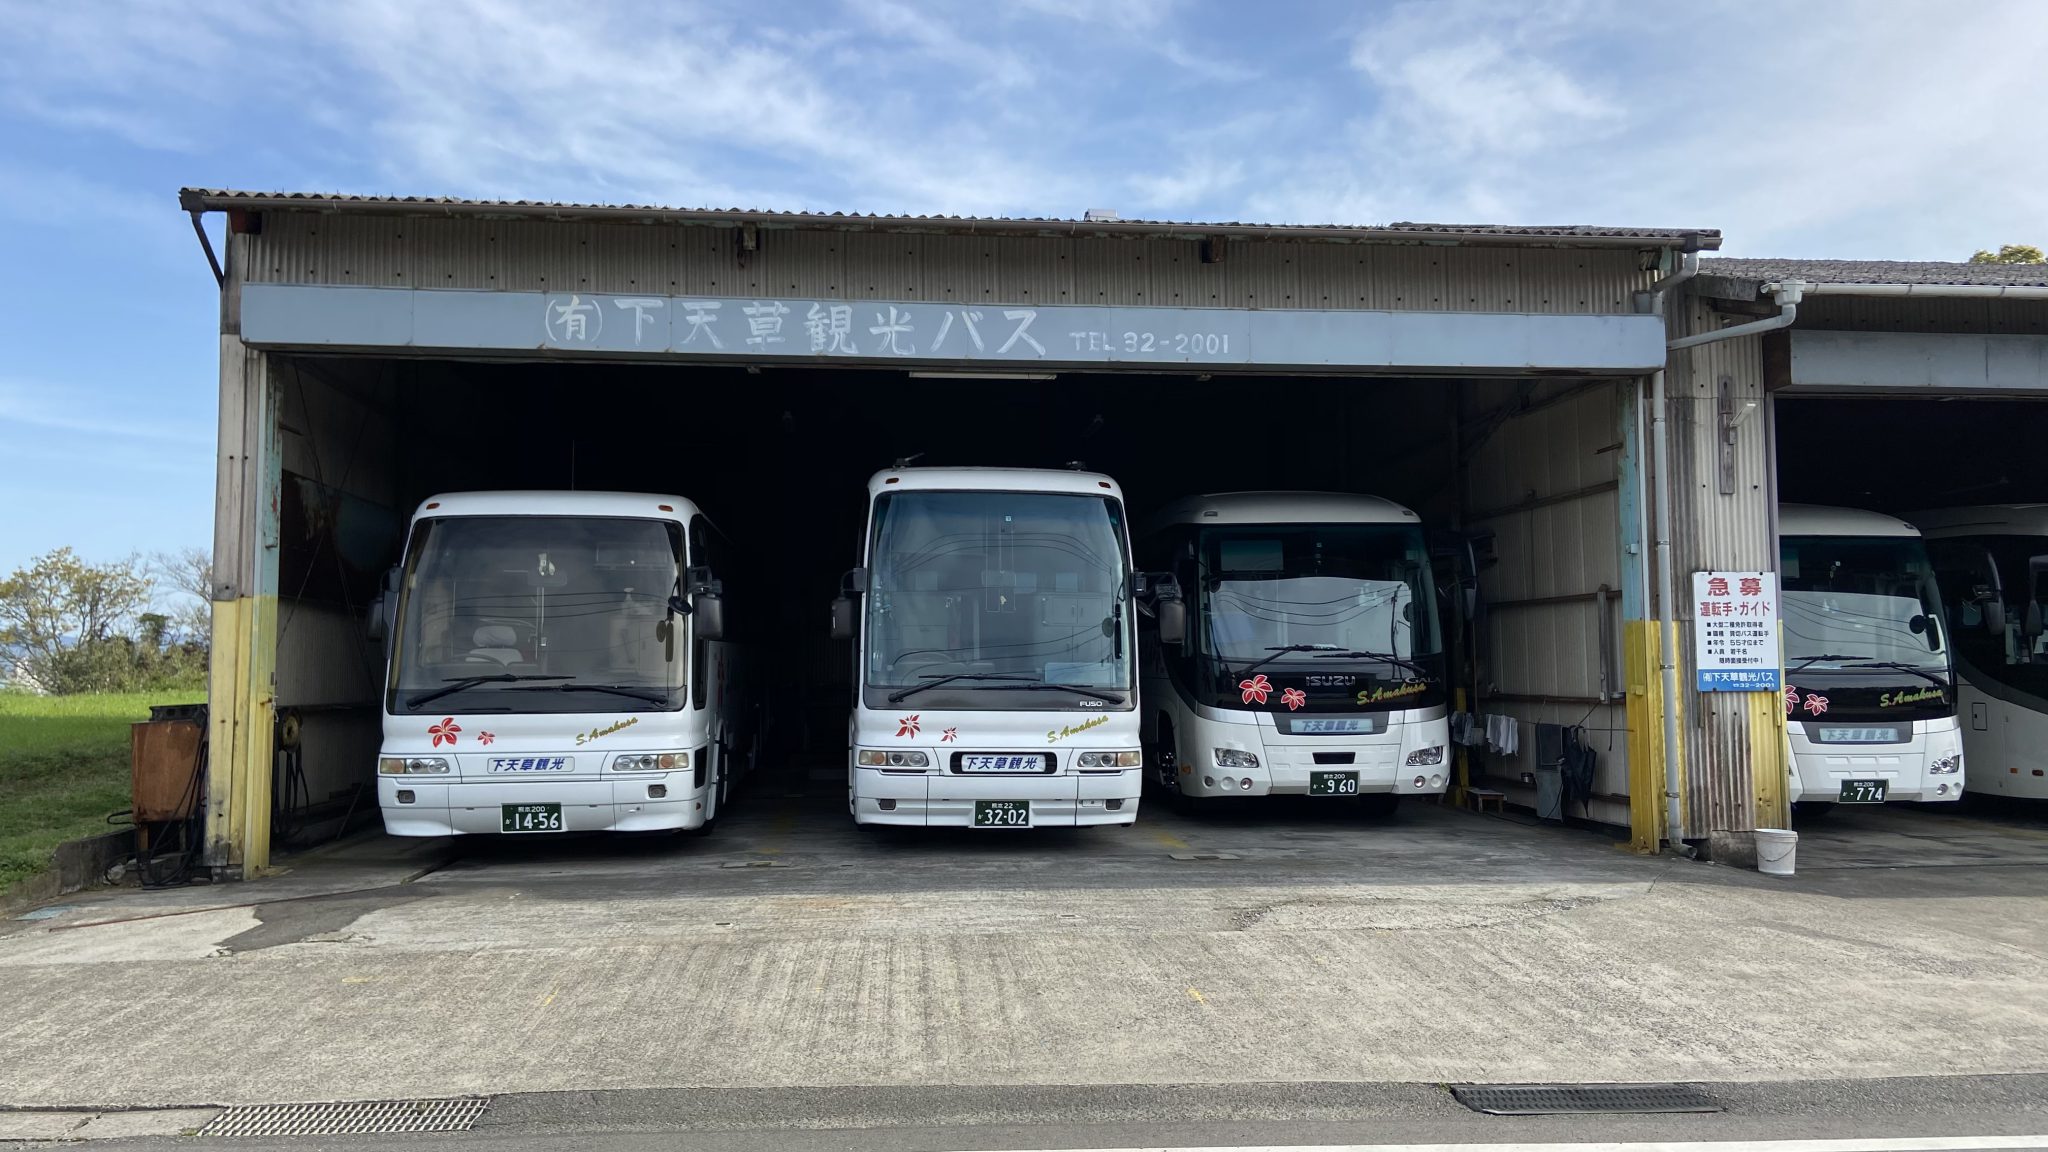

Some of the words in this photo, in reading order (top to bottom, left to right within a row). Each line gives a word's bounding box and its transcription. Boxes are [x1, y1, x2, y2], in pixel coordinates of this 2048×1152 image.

[1069, 331, 1116, 352] TEL
[1123, 331, 1229, 354] 32-2001
[1707, 577, 1762, 597] 急募
[1700, 601, 1770, 617] 運転手・ガイド
[1305, 675, 1356, 687] ISUZU
[515, 812, 559, 830] 14-56
[984, 809, 1027, 825] 32-02
